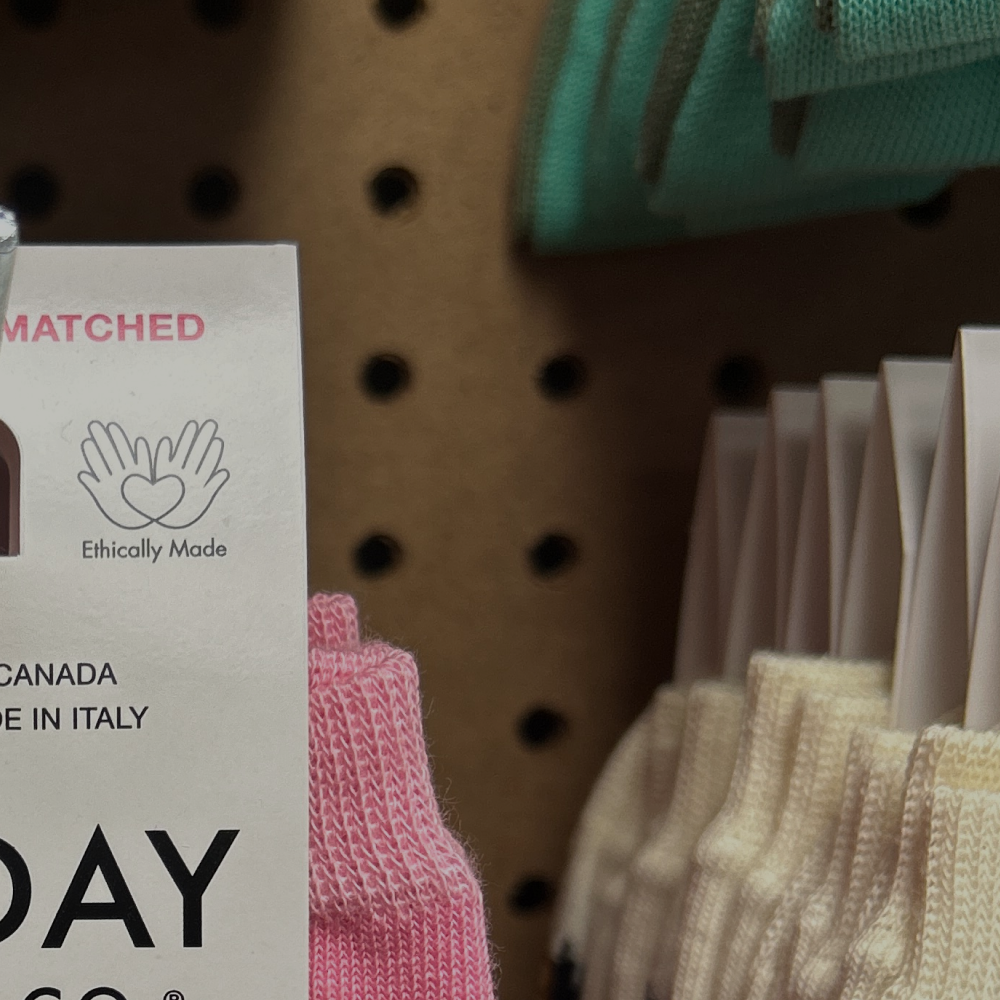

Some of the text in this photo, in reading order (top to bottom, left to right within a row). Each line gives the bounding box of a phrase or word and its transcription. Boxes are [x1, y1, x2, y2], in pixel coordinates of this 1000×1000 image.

[83, 537, 227, 563] Ethically Made
[33, 707, 60, 730] IN
[73, 706, 149, 730] ITALY
